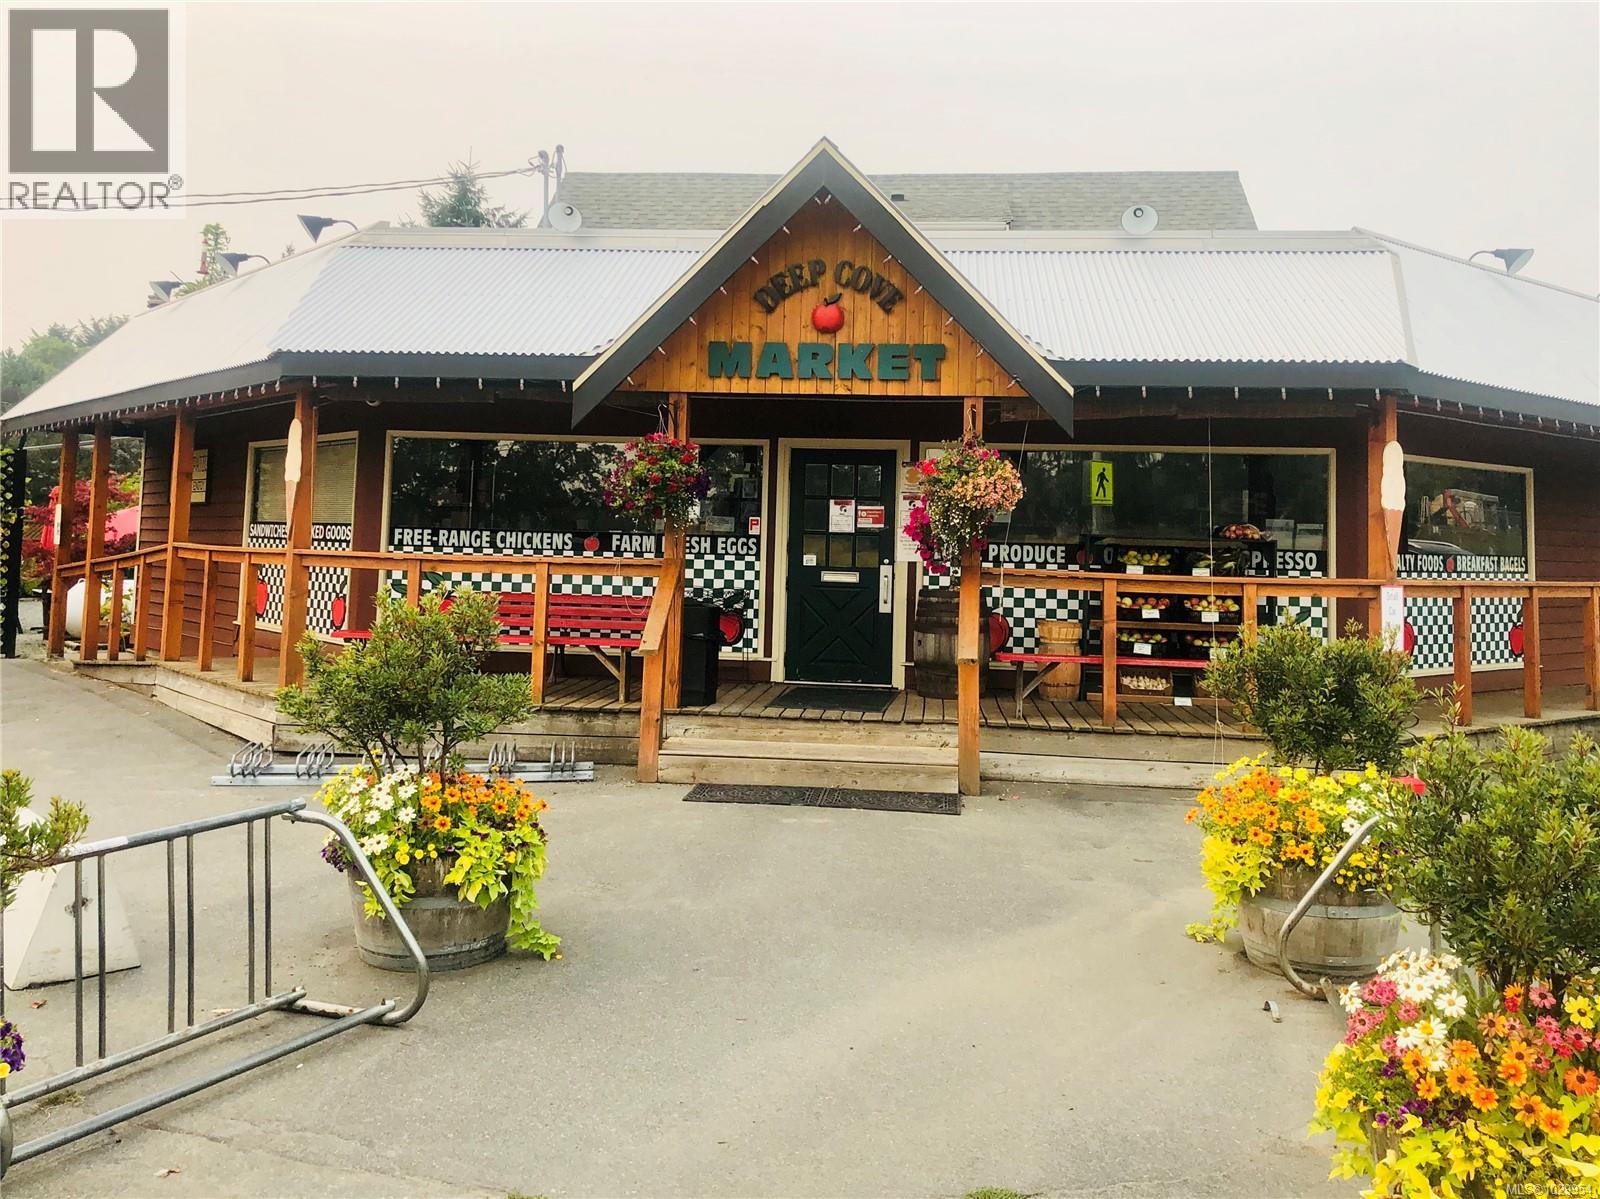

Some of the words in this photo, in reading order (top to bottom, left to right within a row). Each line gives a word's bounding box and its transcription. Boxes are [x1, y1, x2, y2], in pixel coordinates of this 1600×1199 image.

[753, 259, 827, 315] DEEP
[834, 260, 905, 315] COVE
[708, 341, 946, 381] MARKET
[325, 525, 352, 541] GOODS
[394, 528, 491, 548] FREE-RANGE
[496, 531, 573, 550] CHICKENS
[612, 534, 656, 552] FARM
[662, 536, 711, 554] ESH
[717, 537, 757, 555] EGGS
[988, 544, 1067, 564] PRODUCE
[1417, 554, 1444, 572] FOODS
[1456, 555, 1498, 573] BREAKFAST
[1500, 556, 1526, 573] BAGELS
